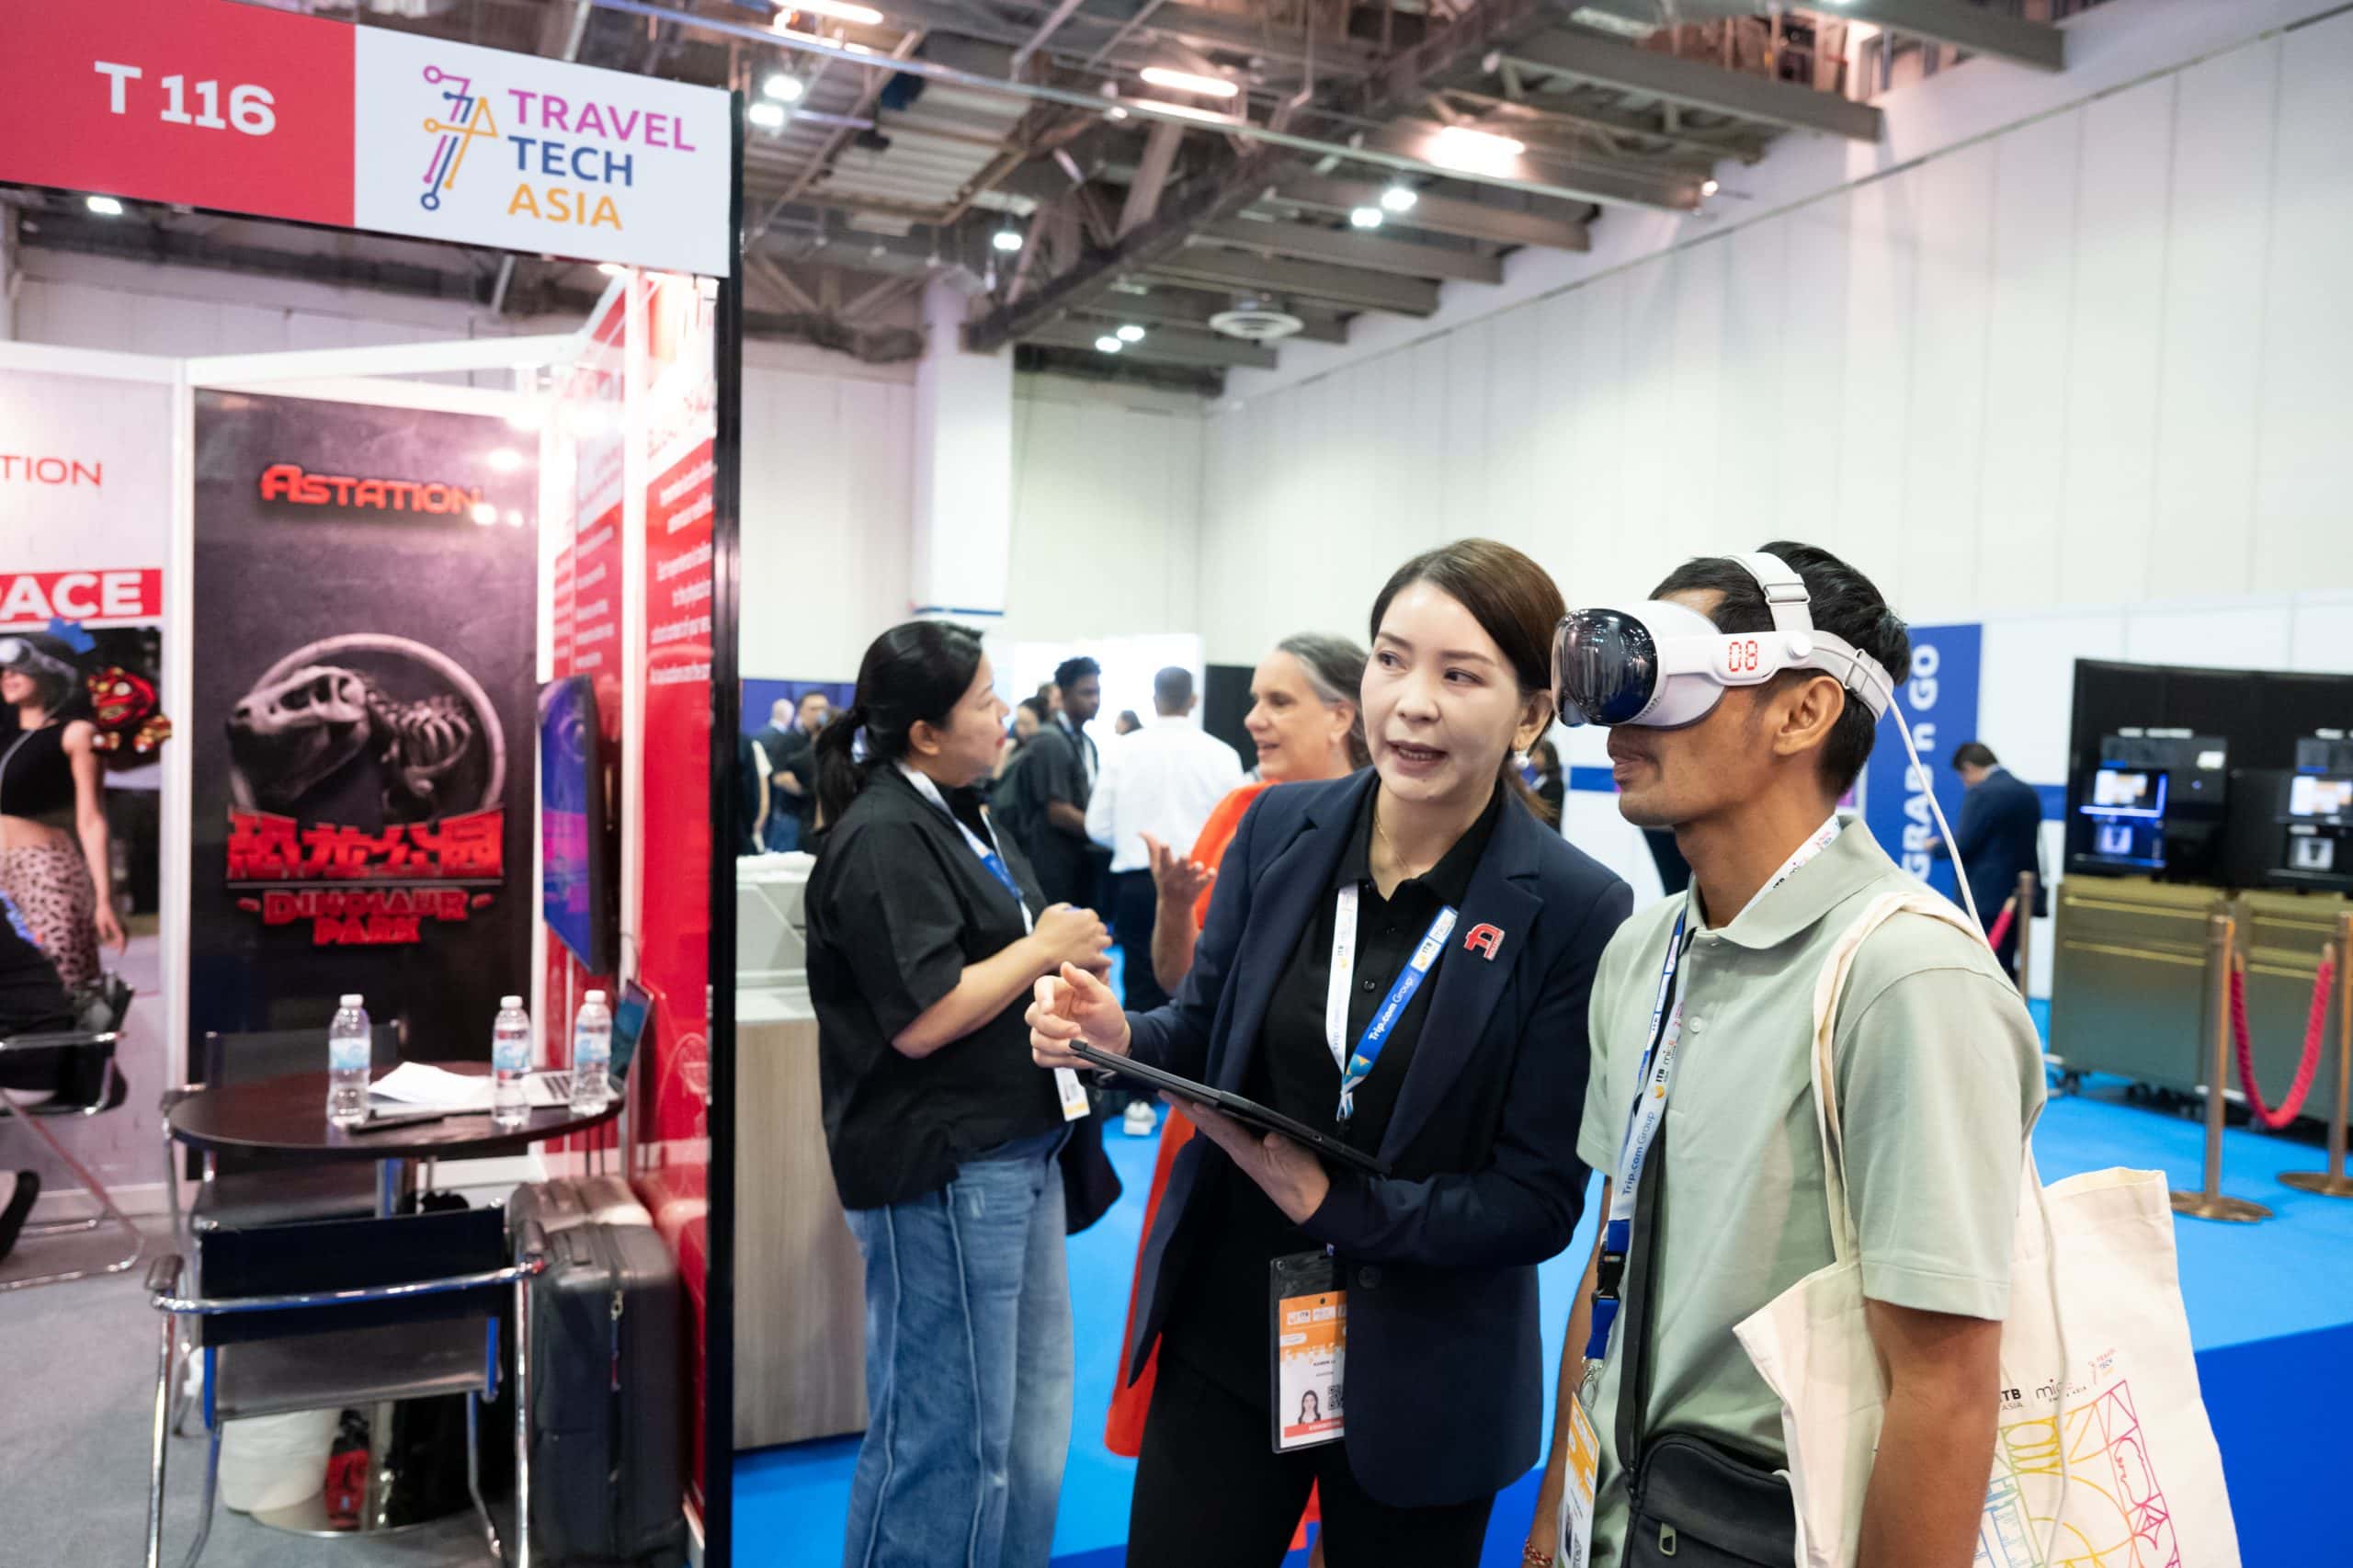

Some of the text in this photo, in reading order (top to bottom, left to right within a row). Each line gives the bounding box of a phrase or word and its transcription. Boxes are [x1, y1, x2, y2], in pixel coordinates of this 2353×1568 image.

[94, 61, 277, 137] T 116
[508, 88, 696, 153] TRAVEL
[508, 135, 632, 187] TECH
[507, 183, 622, 230] ASIA
[0, 572, 144, 621] ACE
[1728, 640, 1758, 672] 08
[1907, 643, 1940, 711] GO
[1912, 722, 1937, 752] n
[1368, 1003, 1397, 1040] Trip.com
[1392, 976, 1414, 1004] Group
[1637, 1110, 1654, 1144] Group
[2000, 1388, 2022, 1403] TB
